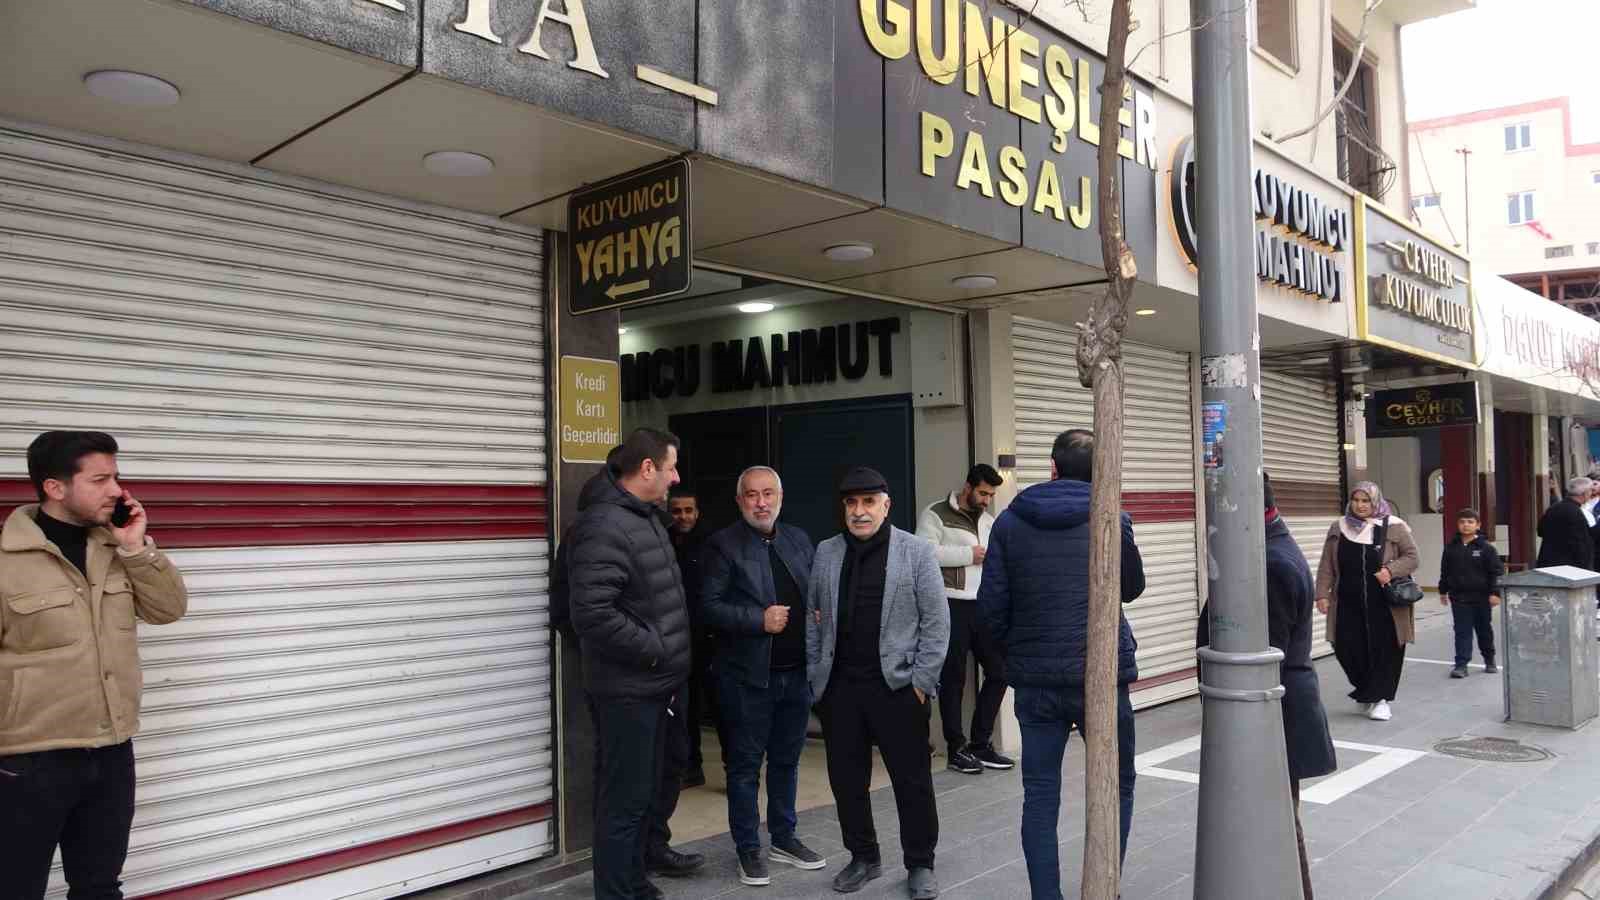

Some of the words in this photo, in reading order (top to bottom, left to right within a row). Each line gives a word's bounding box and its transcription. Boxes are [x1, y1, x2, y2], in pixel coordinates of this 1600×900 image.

[921, 111, 1092, 229] PASAJ
[577, 176, 679, 231] KUYUMCU
[575, 216, 681, 285] YAHYA
[1255, 230, 1346, 303] MAHMUT
[1405, 239, 1455, 289] CEVHER
[1386, 273, 1473, 335] KUYUMCULUK
[575, 372, 606, 392] Kredi
[711, 317, 900, 394] MAHMUT
[562, 424, 620, 447] Geçerlidir
[1406, 414, 1445, 426] GOLD
